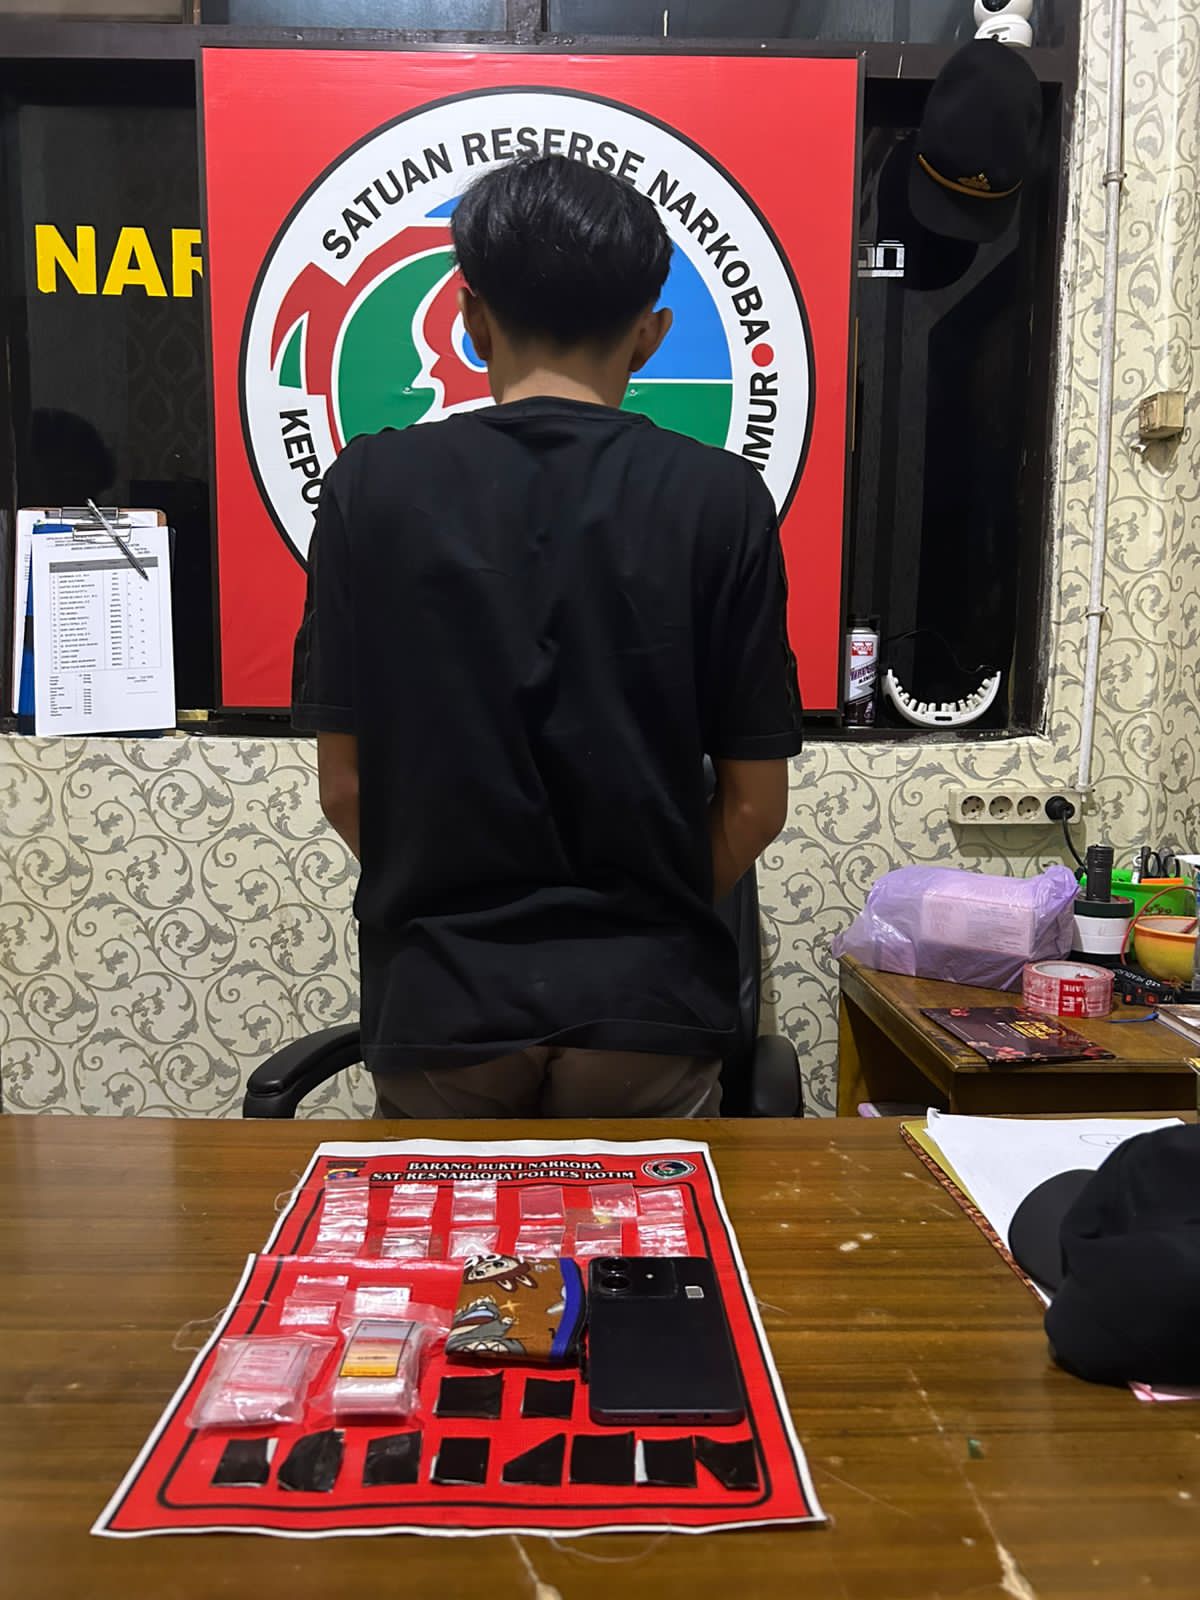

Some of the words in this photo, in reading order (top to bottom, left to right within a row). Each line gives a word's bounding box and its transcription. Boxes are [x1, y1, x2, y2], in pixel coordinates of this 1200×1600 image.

[322, 143, 453, 259] SATUAN
[461, 126, 645, 185] RESERSE
[646, 169, 771, 345] NARKOBA
[279, 408, 323, 513] KEPO
[371, 1171, 402, 1181] SAT
[405, 1171, 513, 1181] RESNARKOBA
[518, 1169, 580, 1180] POLRES
[584, 1171, 635, 1180] KOTIM
[407, 1161, 473, 1171] BARANG
[477, 1161, 523, 1171] BUKTI
[527, 1160, 602, 1170] NARKOBA
